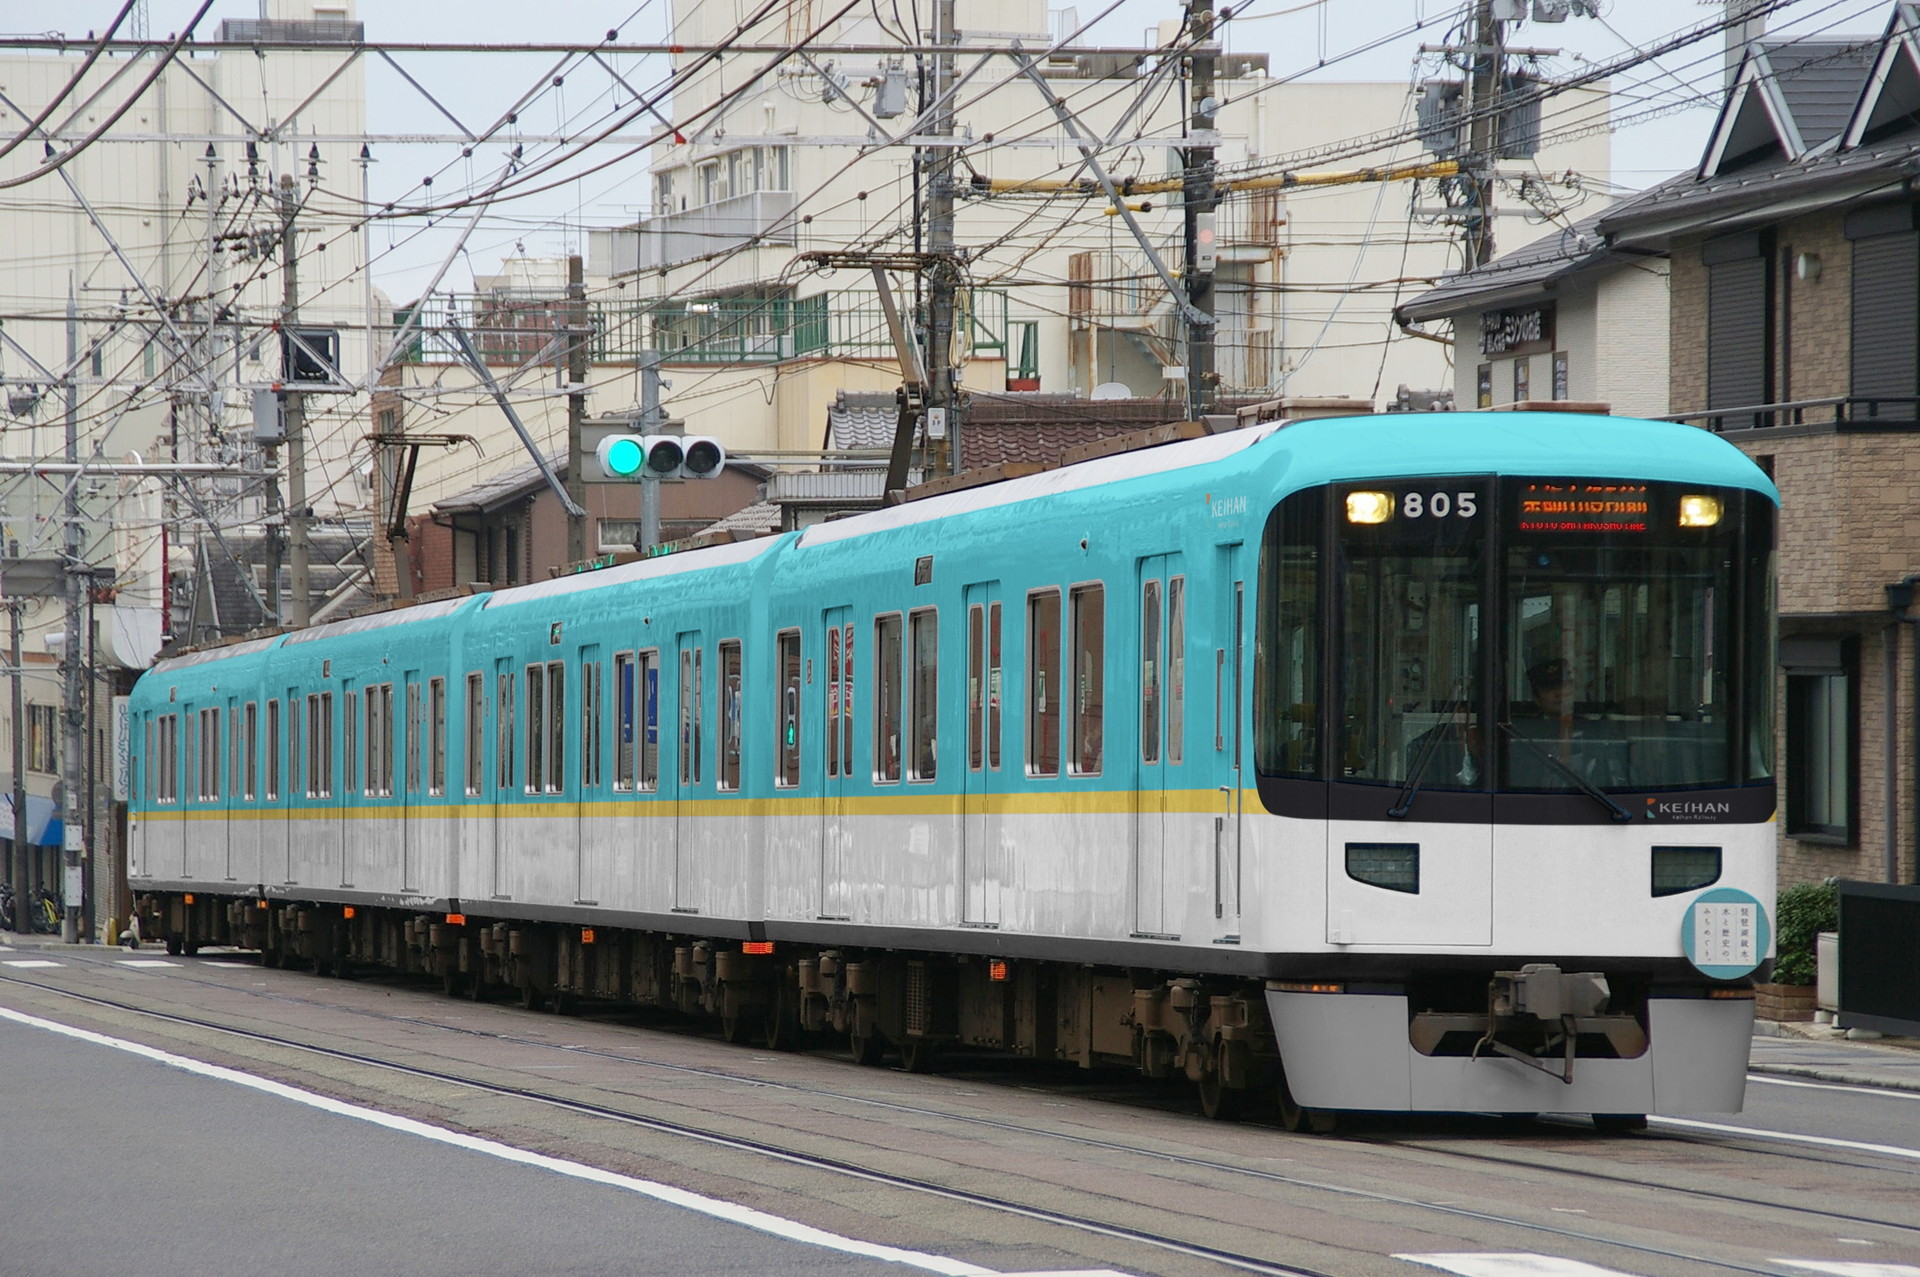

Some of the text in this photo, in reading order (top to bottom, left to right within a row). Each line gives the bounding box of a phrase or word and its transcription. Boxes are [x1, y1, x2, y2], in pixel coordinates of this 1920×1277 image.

[1211, 496, 1247, 518] KEIHAN
[1403, 492, 1477, 518] 805
[1660, 802, 1730, 813] KEIHAN
